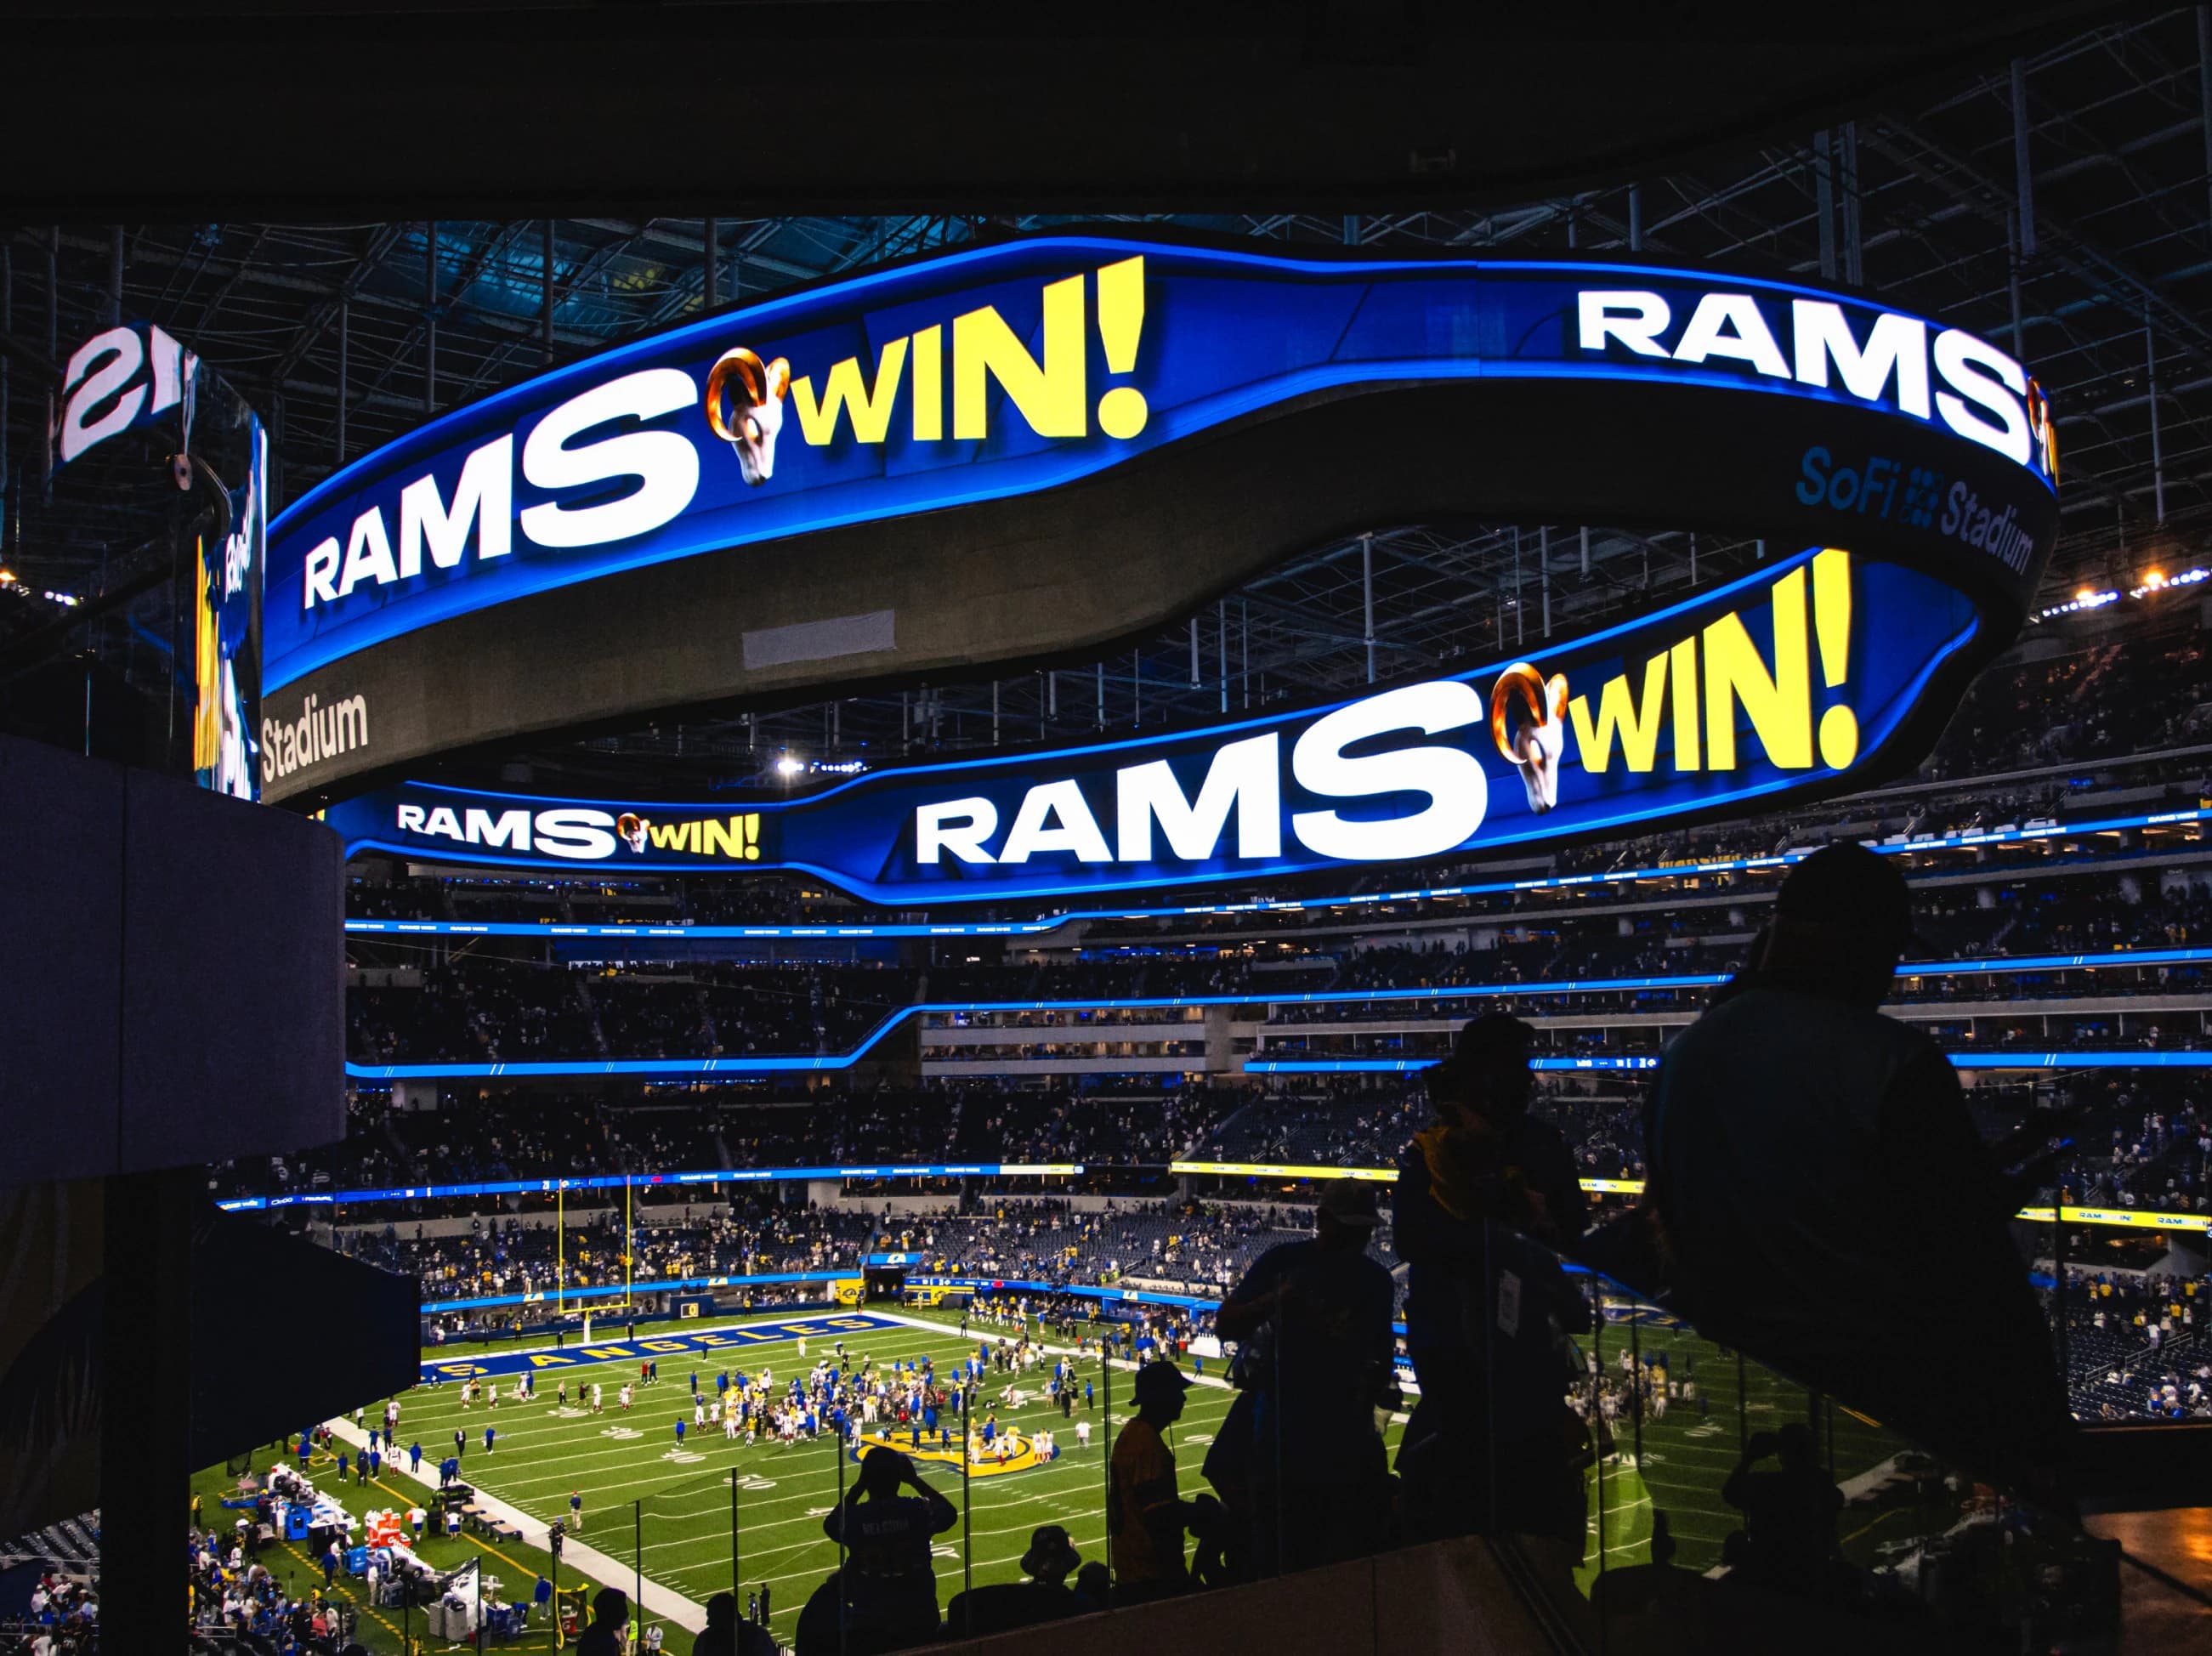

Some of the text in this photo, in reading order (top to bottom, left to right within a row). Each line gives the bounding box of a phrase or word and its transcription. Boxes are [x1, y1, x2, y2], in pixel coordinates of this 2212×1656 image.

[304, 369, 700, 609] RAMS
[791, 255, 1148, 445] WIN!
[1578, 291, 2030, 465] RAMS
[1795, 445, 2034, 576] SoFi Stadium
[263, 693, 368, 782] Stadium
[917, 548, 1857, 860] RAMS WIN!
[398, 804, 759, 860] RAMS WIN!
[529, 1319, 875, 1367] ANGELES
